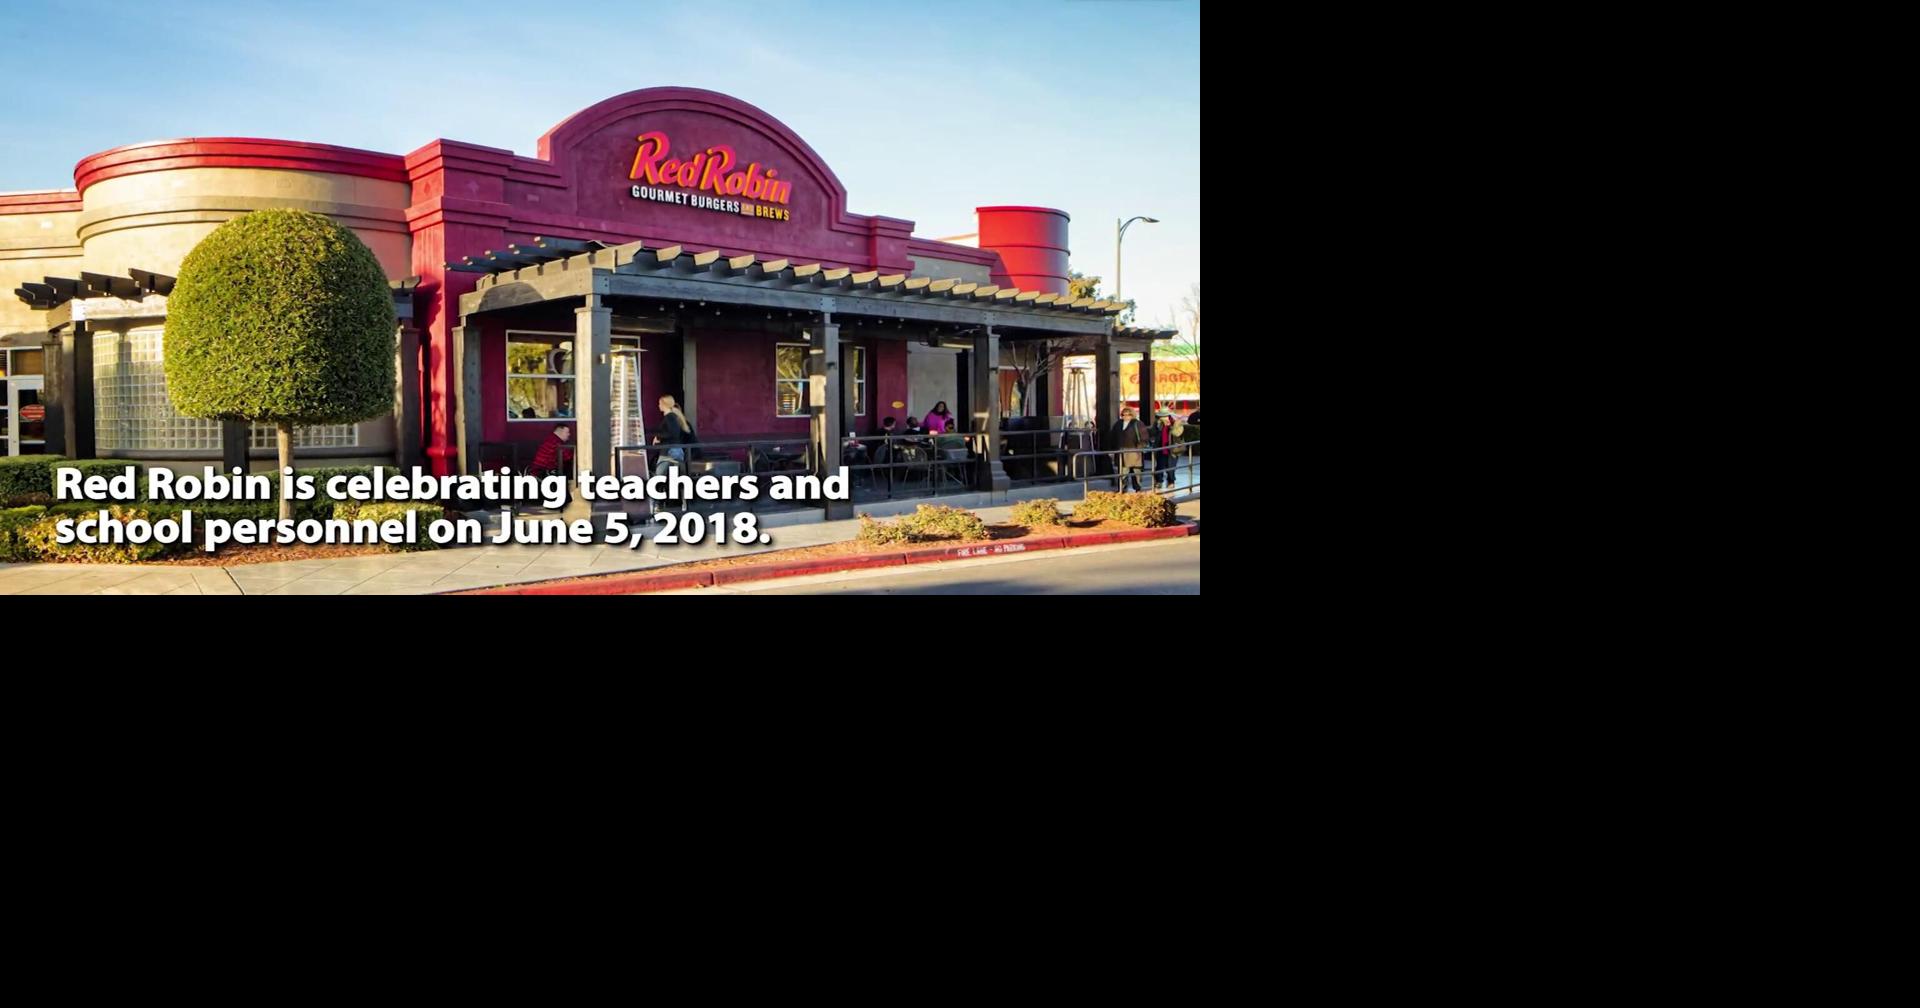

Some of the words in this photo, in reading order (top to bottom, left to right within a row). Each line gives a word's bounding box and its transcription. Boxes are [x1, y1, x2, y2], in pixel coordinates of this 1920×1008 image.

[629, 131, 706, 187] Red
[700, 144, 792, 204] Robin
[632, 185, 689, 205] GOURMET
[691, 195, 740, 213] BURGERS
[756, 205, 790, 221] BREWS
